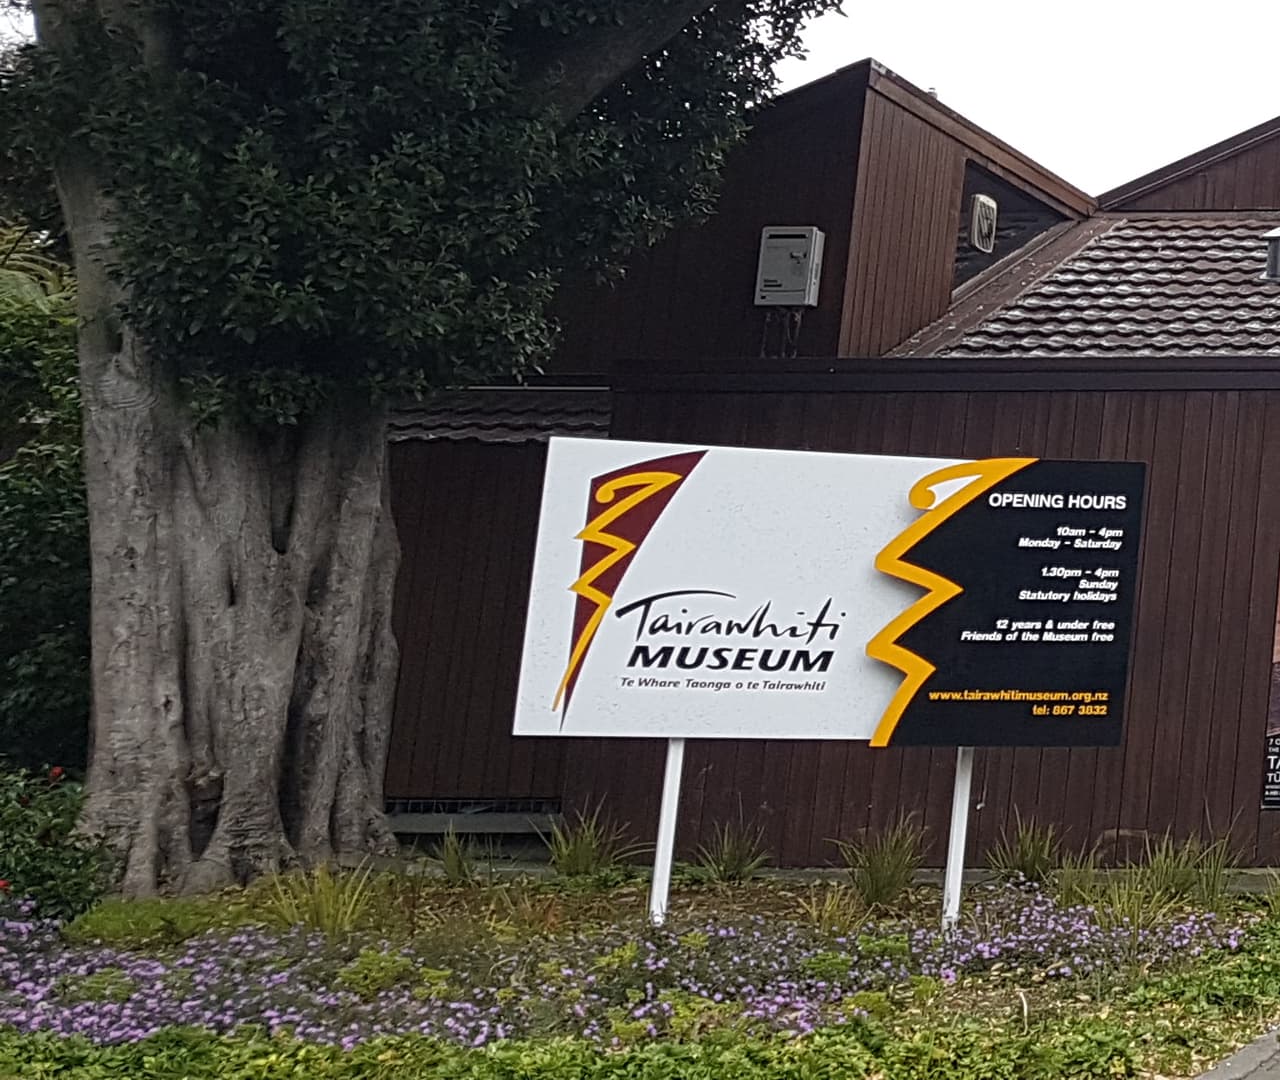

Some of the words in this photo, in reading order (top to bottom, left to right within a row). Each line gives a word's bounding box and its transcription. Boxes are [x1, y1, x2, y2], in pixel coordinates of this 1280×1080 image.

[988, 493, 1064, 509] OPENING
[1068, 494, 1127, 510] HOURS
[1056, 526, 1086, 537] 10am
[1098, 526, 1124, 539] 4pm
[1018, 537, 1061, 550] Monday
[1073, 538, 1123, 551] Saturday
[1041, 567, 1082, 579] 1.30pm
[1094, 568, 1120, 579] 4pm
[1078, 578, 1119, 591] Sunday
[1018, 590, 1071, 603] Statutory
[1073, 591, 1118, 603] holidays
[615, 590, 847, 645] Tairawhiti
[996, 620, 1009, 630] 12
[1011, 620, 1042, 631] years
[1057, 620, 1090, 630] under
[1092, 620, 1116, 630] free
[960, 631, 1002, 642] Friends
[1005, 631, 1019, 642] of
[1021, 631, 1040, 642] the
[1042, 631, 1089, 642] Museum
[1091, 631, 1115, 642] free
[626, 645, 836, 672] MUSEUM
[620, 677, 635, 687] Te
[638, 678, 681, 688] Whare
[685, 679, 731, 692] Taonga
[747, 681, 759, 690] te
[762, 681, 827, 691] Tairawhiti
[928, 689, 1109, 703] www.tairawhitimuseum.org.nz
[1032, 705, 1050, 716] tel:
